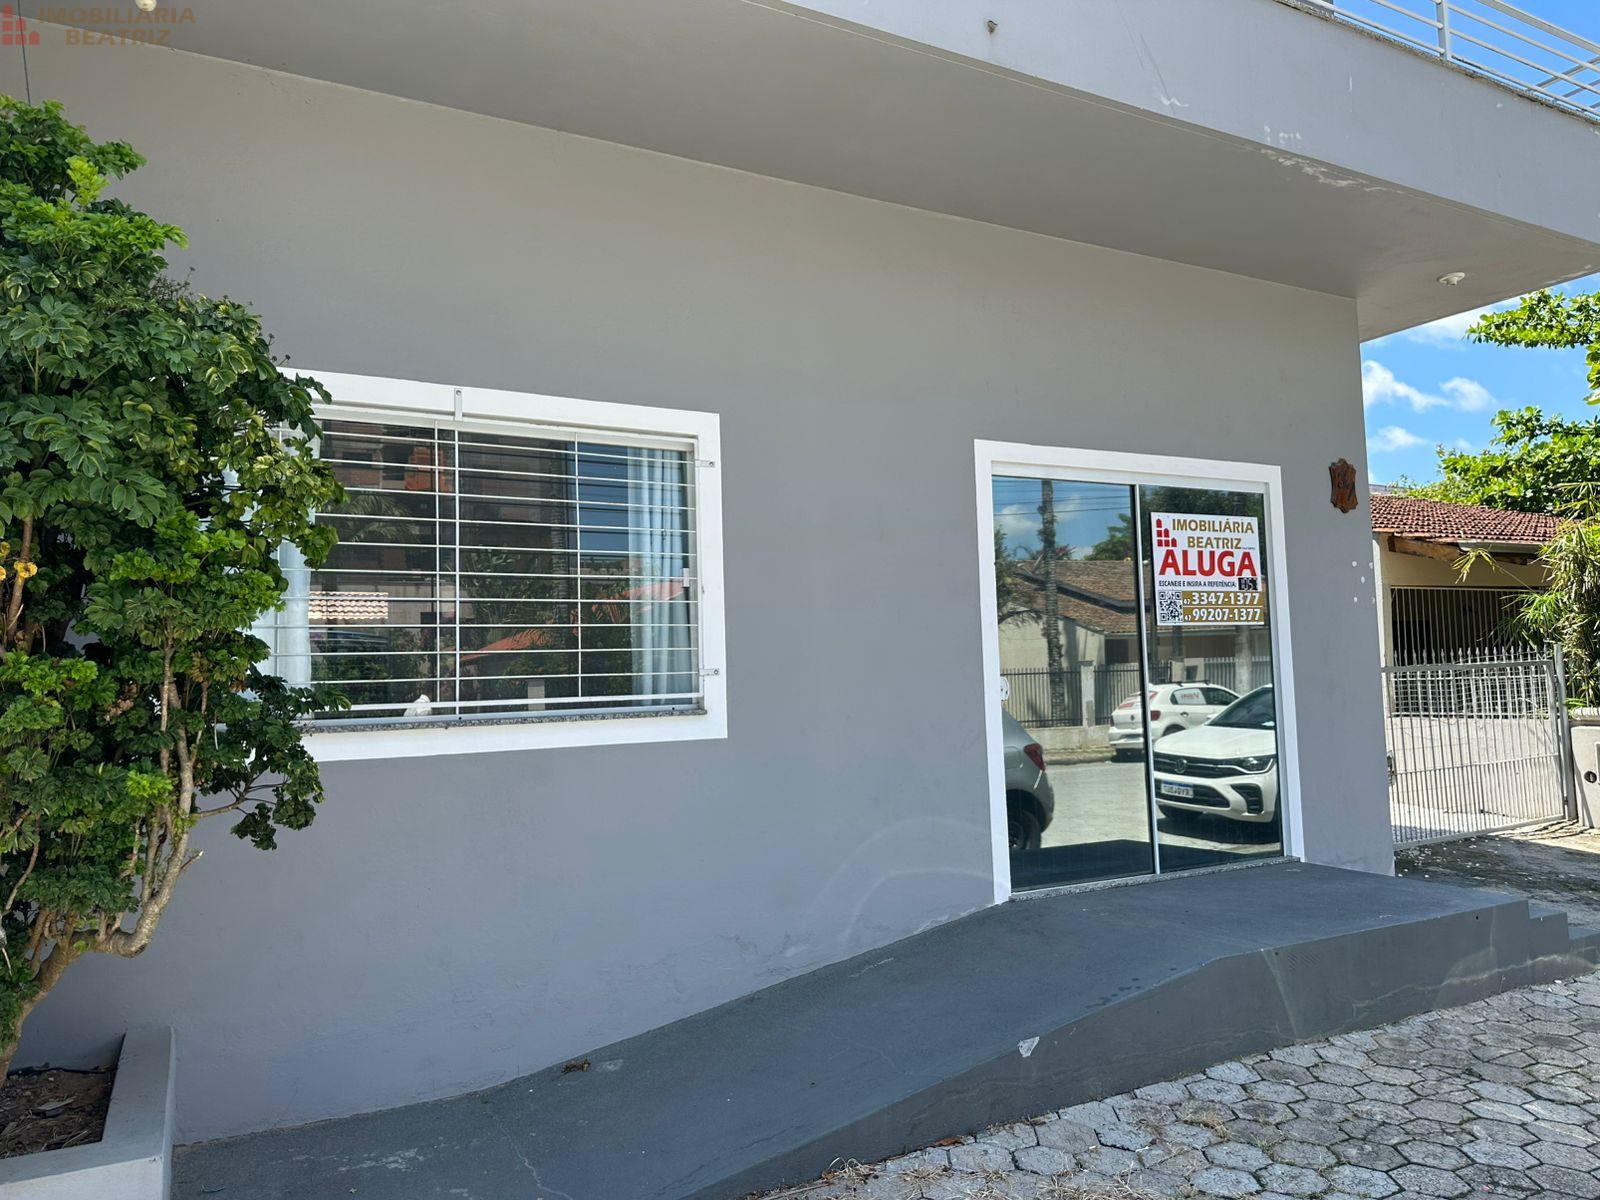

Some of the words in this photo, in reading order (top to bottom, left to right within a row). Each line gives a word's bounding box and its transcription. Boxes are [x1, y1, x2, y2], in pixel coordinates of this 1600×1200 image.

[1172, 518, 1254, 534] IMOBILIÁRIA
[1187, 536, 1242, 549] BEATRIZ
[1158, 549, 1257, 577] ALUGA
[1192, 592, 1260, 605] 3347-1377
[1192, 608, 1261, 621] 99207-1377
